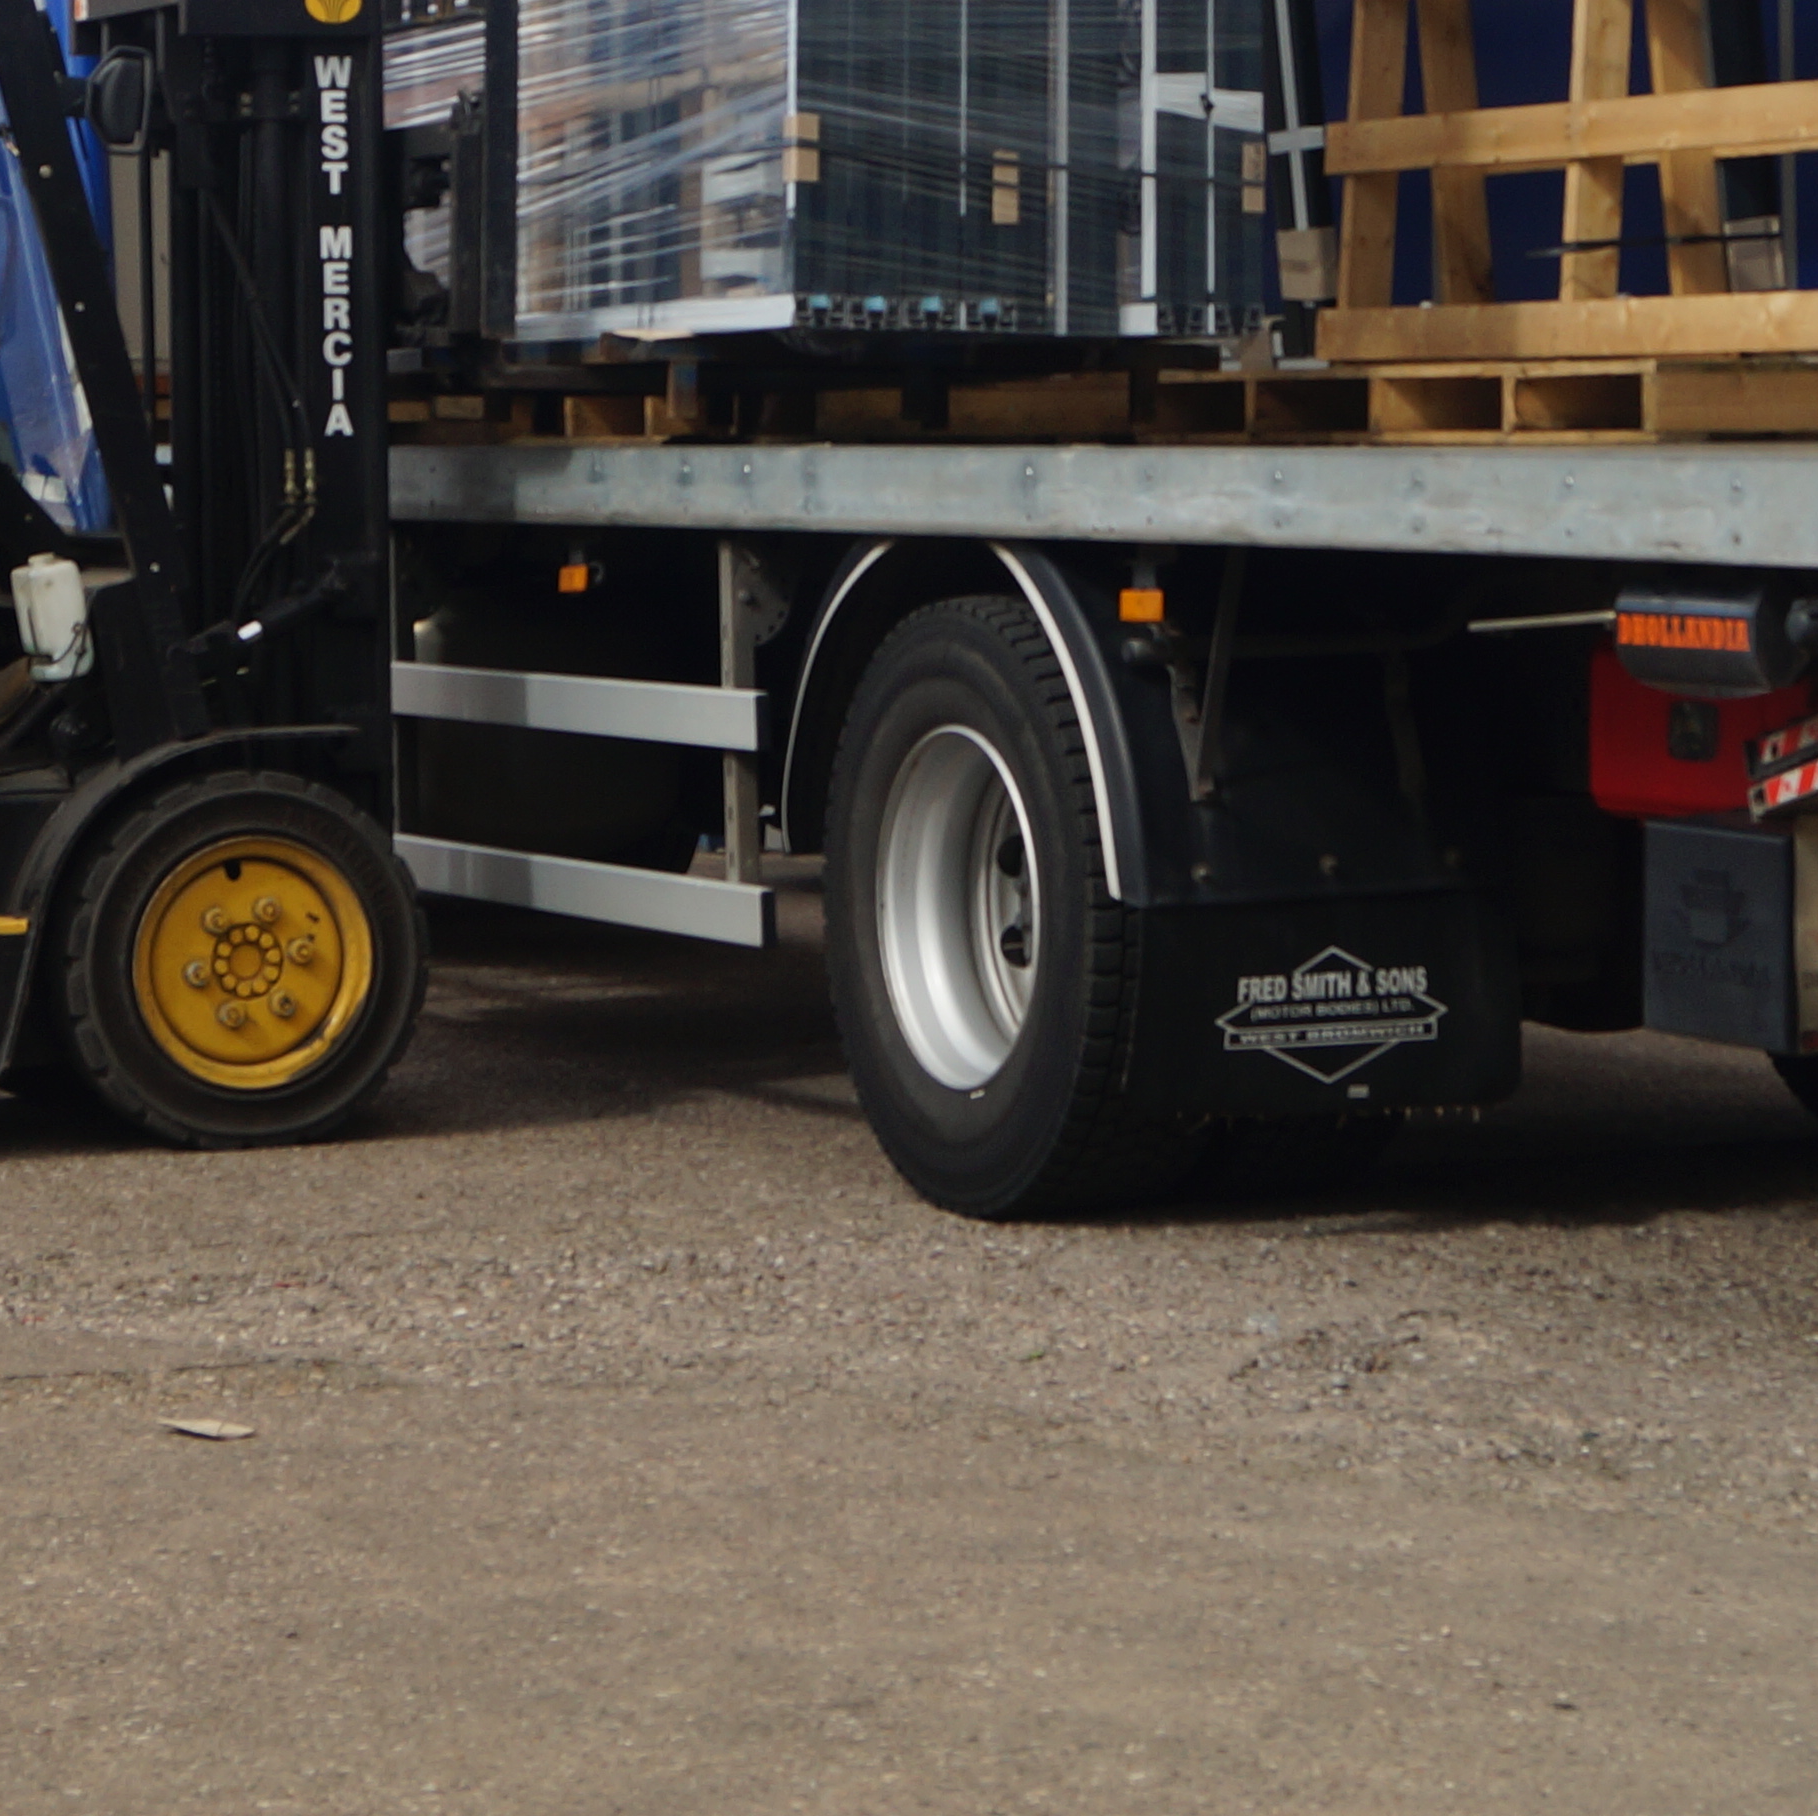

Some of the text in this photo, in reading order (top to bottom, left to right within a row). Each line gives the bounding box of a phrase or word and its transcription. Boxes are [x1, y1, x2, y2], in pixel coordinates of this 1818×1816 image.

[313, 55, 355, 438] WEST MERCIA
[1237, 965, 1428, 1004] FRED SMITH & SONS
